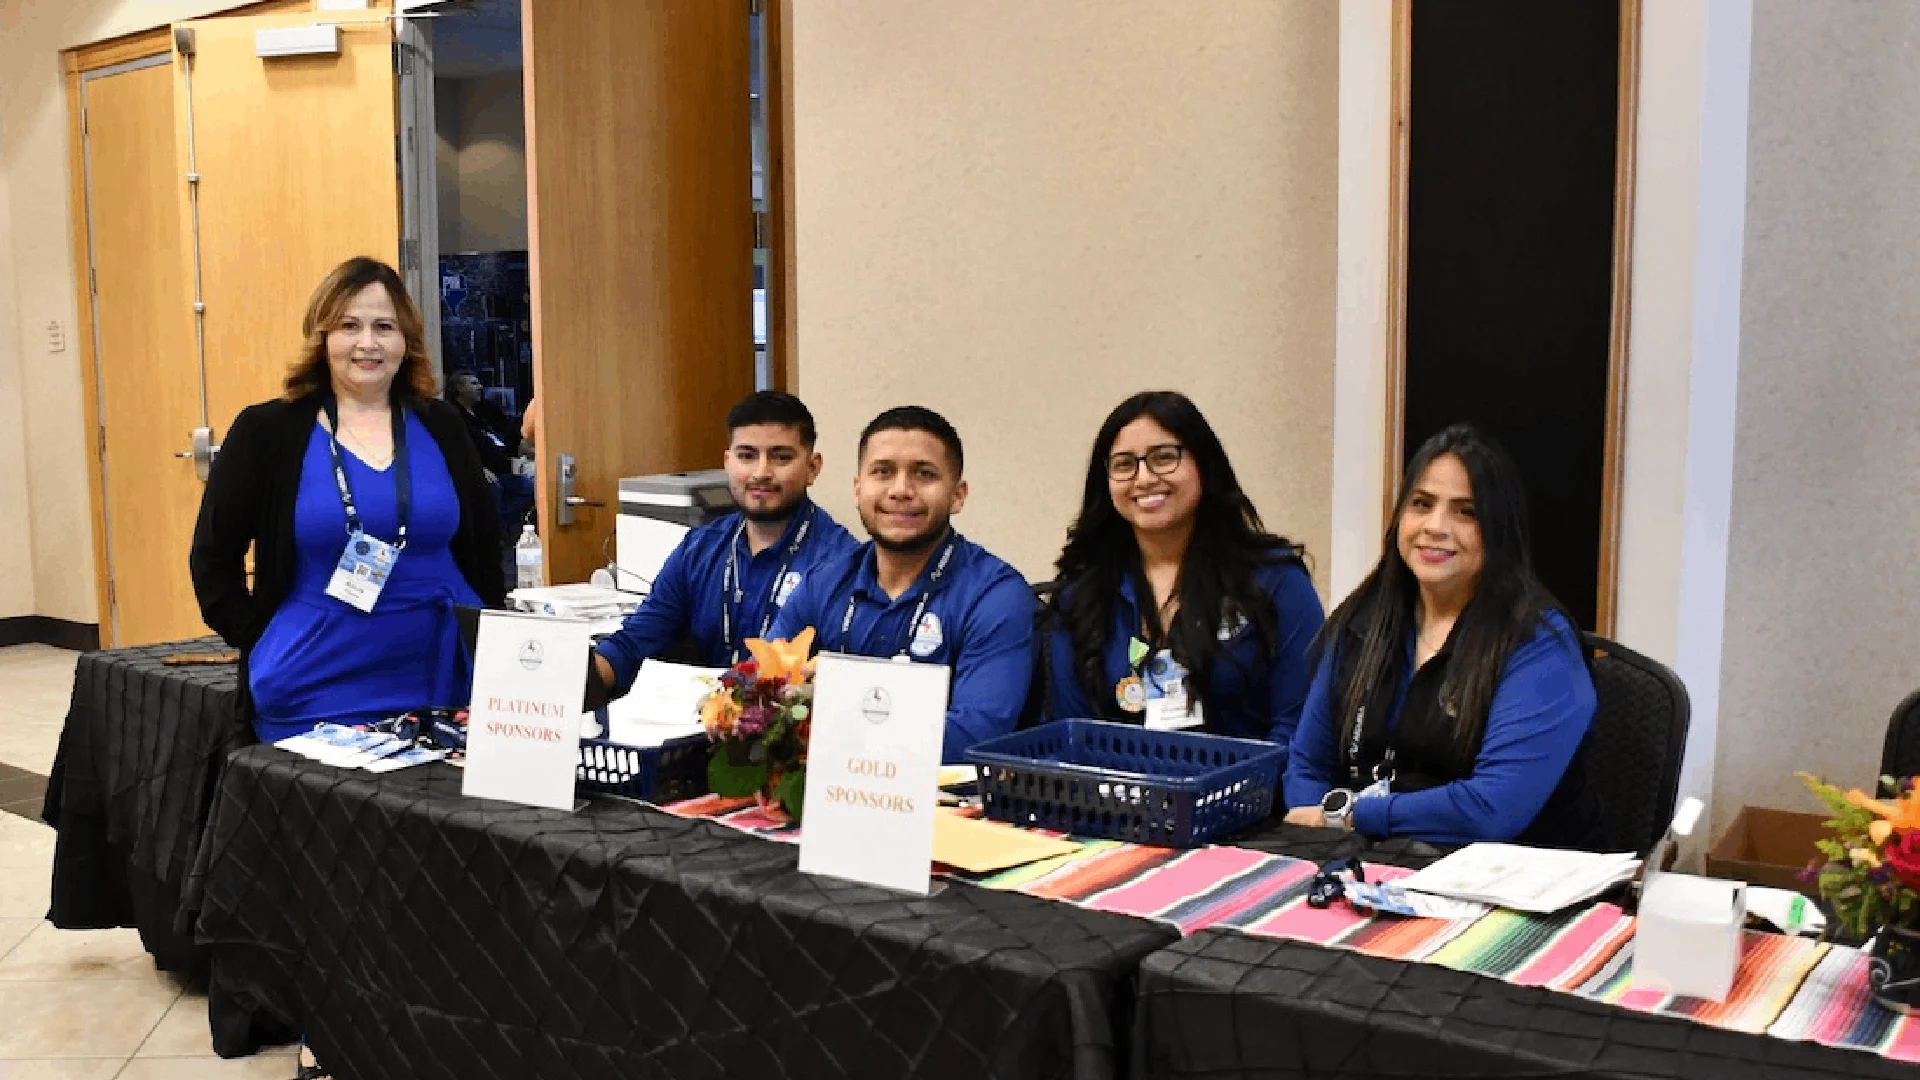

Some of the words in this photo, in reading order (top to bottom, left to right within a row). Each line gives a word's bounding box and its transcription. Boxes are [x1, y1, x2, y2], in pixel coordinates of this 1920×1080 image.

[487, 697, 565, 718] PLATINUM
[486, 720, 563, 743] SPONSORS
[847, 757, 897, 780] GOLD
[825, 784, 915, 814] SPONSORS
